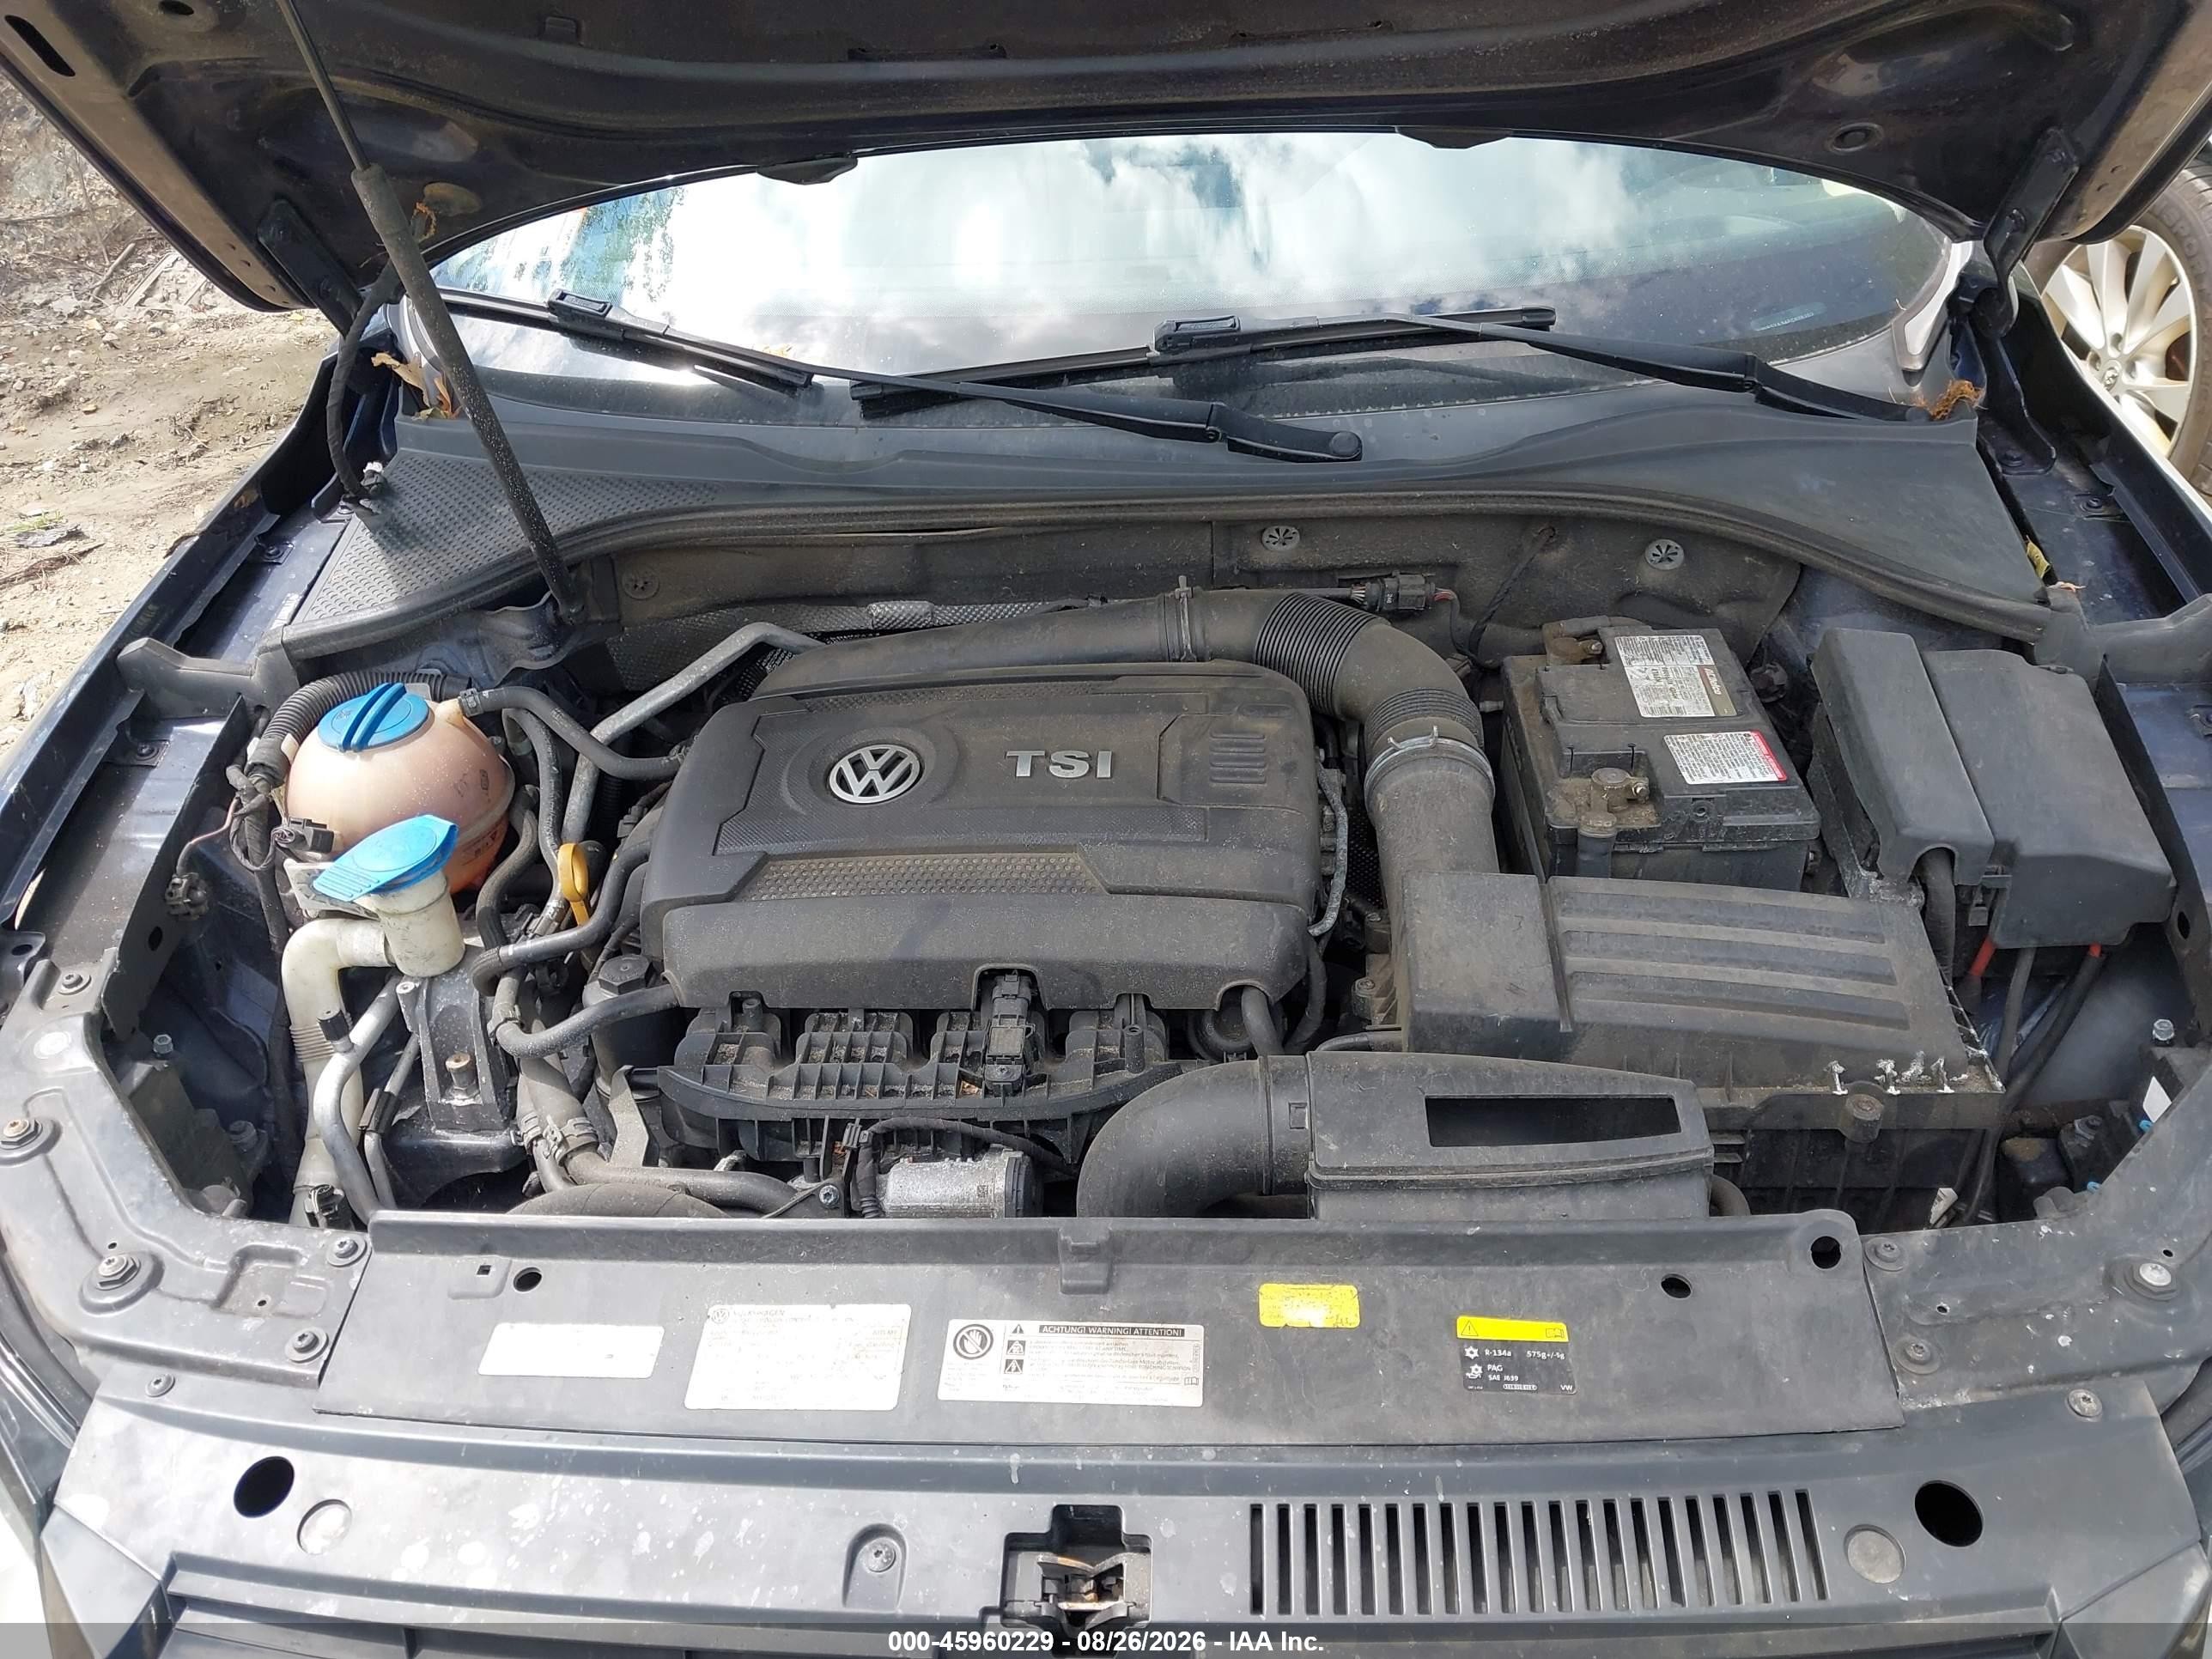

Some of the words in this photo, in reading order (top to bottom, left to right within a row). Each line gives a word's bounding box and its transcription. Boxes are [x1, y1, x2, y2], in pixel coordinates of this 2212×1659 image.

[1006, 750, 1113, 779] TSI
[1042, 1325, 1086, 1334] ACHTUNG!
[1089, 1327, 1132, 1335] WARNING!
[1133, 1328, 1182, 1337] ATTENTION!
[1487, 1364, 1503, 1372] PAG
